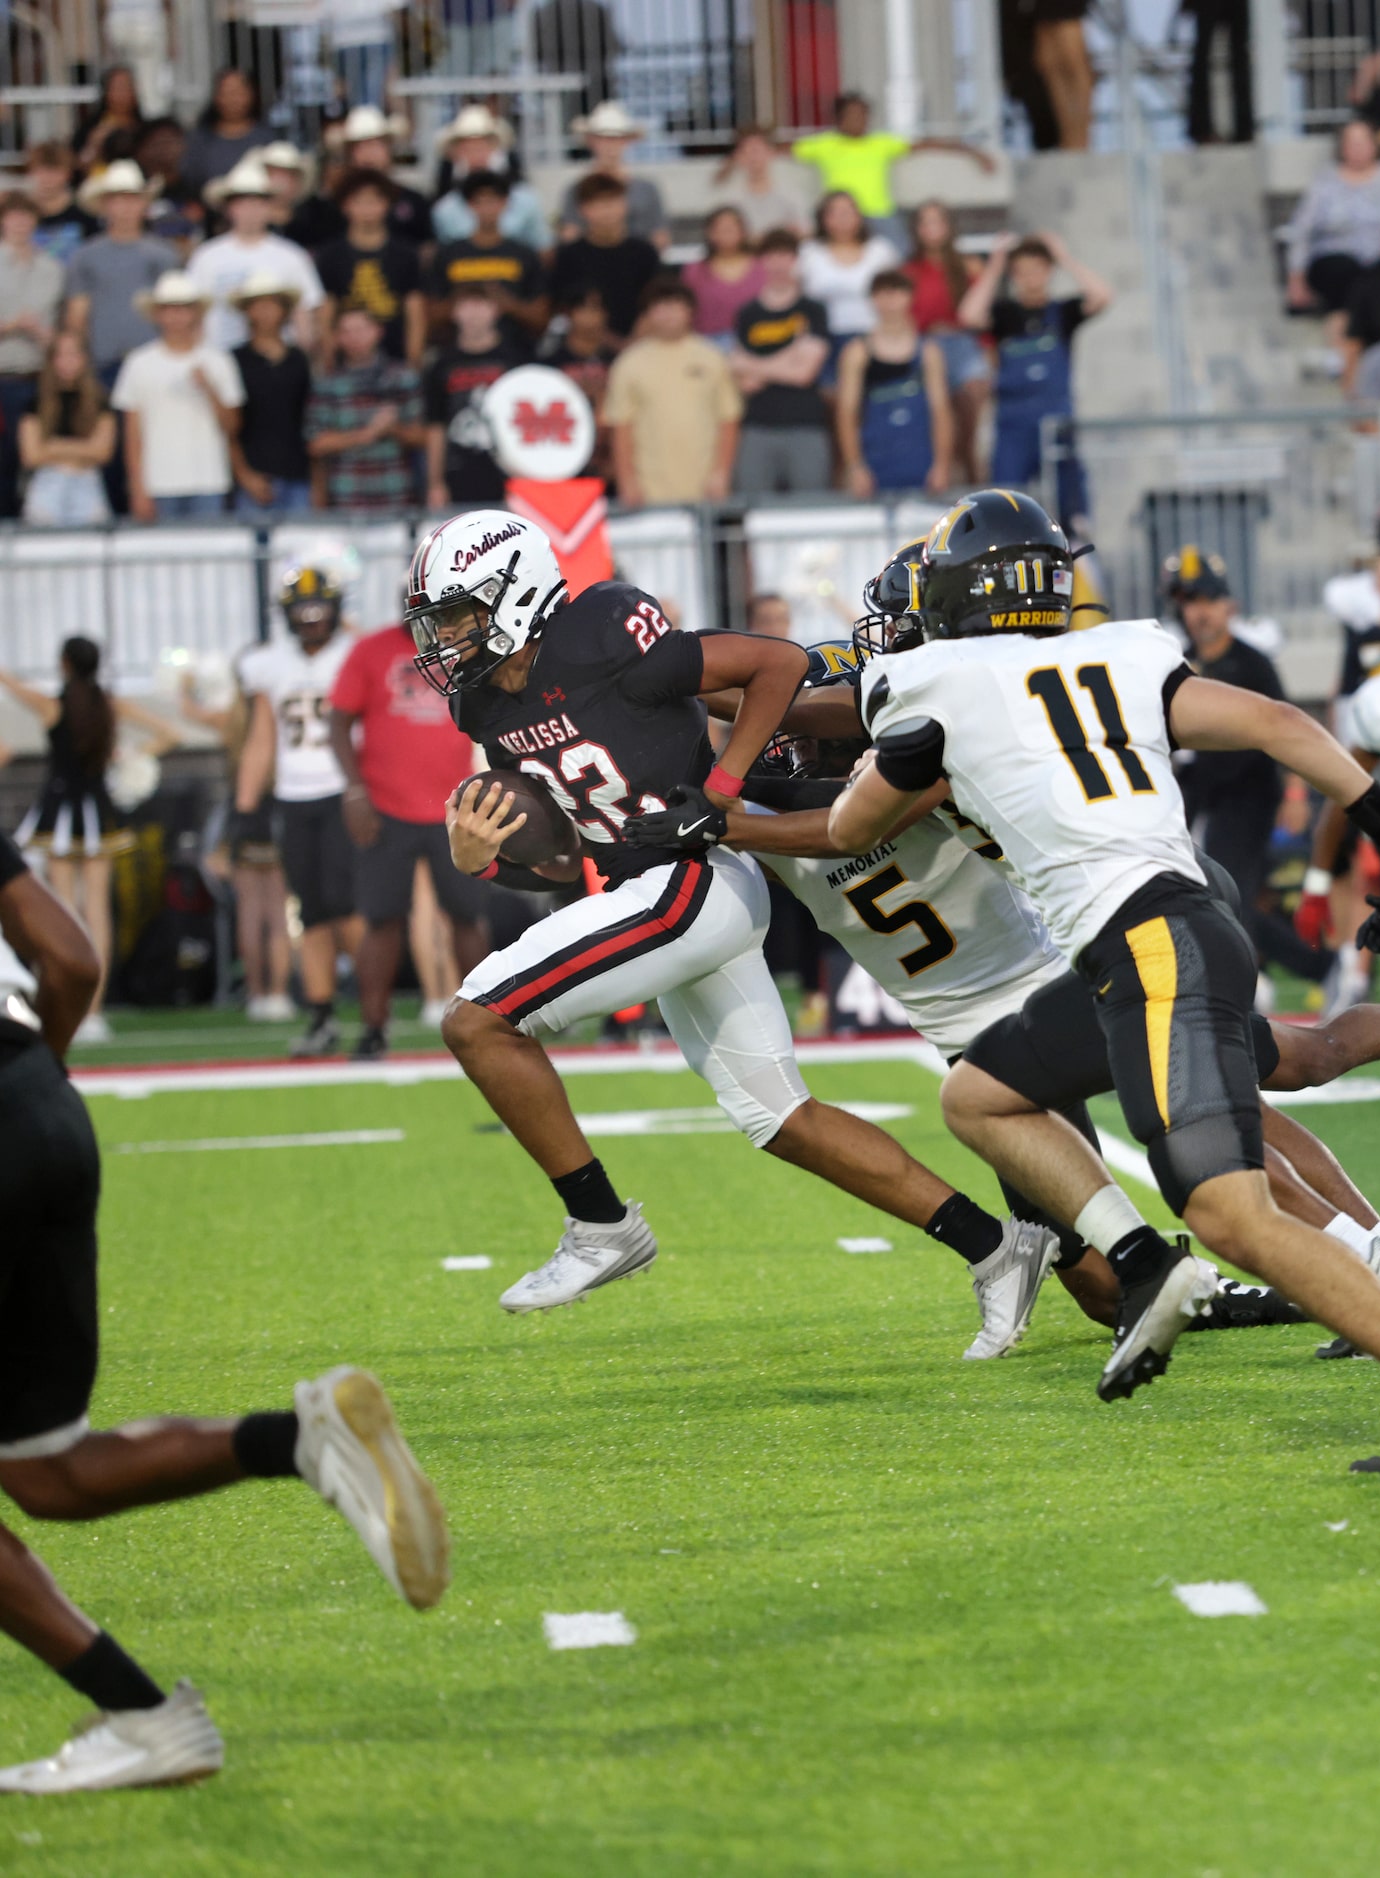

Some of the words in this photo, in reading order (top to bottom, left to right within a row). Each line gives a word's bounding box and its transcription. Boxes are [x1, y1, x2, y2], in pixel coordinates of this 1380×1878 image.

[450, 523, 522, 573] Cardinals
[1015, 559, 1044, 594] 11
[624, 600, 672, 656] 22
[498, 712, 580, 756] MELISSA
[1024, 662, 1160, 805] 11
[520, 739, 668, 844] 22
[826, 842, 898, 889] MEMORIAL
[842, 861, 957, 979] 5
